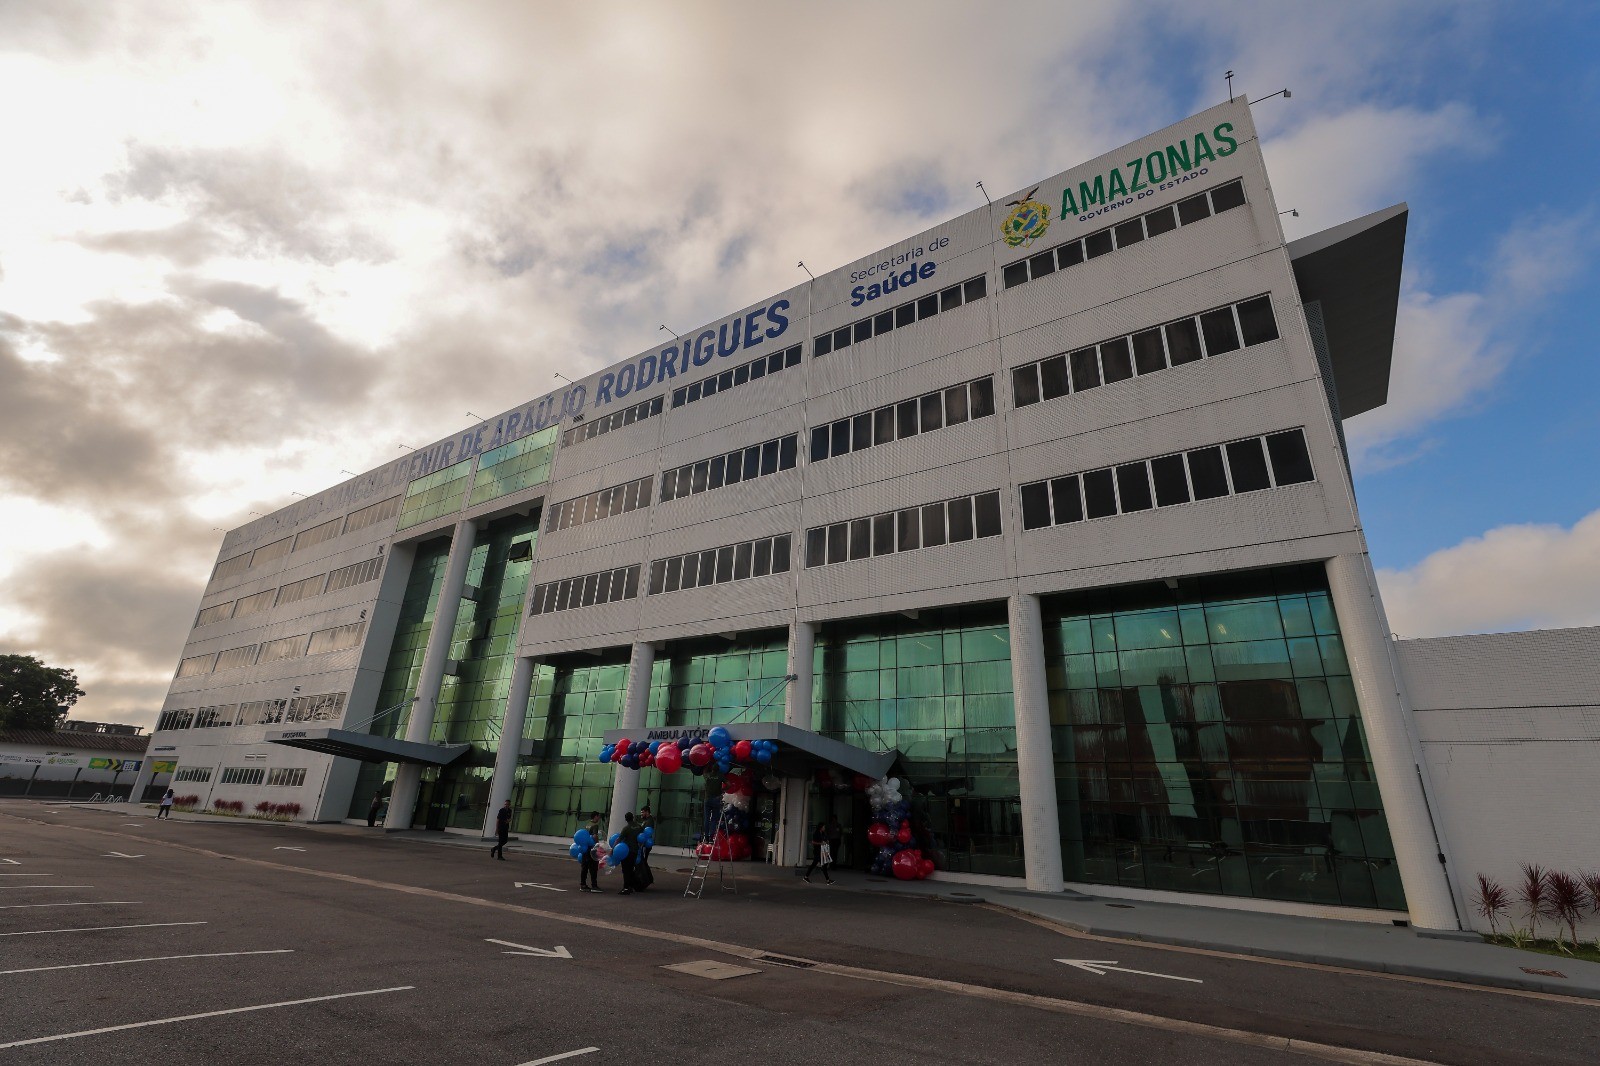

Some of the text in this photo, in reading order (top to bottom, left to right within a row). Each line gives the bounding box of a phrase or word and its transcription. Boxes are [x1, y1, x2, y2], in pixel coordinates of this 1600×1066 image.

[1060, 122, 1238, 221] AMAZONAS
[1079, 168, 1209, 222] GOVERNO DO ESTADO
[850, 236, 950, 284] Secretaria de
[850, 261, 936, 307] Saúde
[457, 425, 489, 461] DE
[490, 385, 587, 447] ARAÚJO
[594, 299, 790, 408] RODRIGUES
[647, 727, 710, 740] AMBULATÓR
